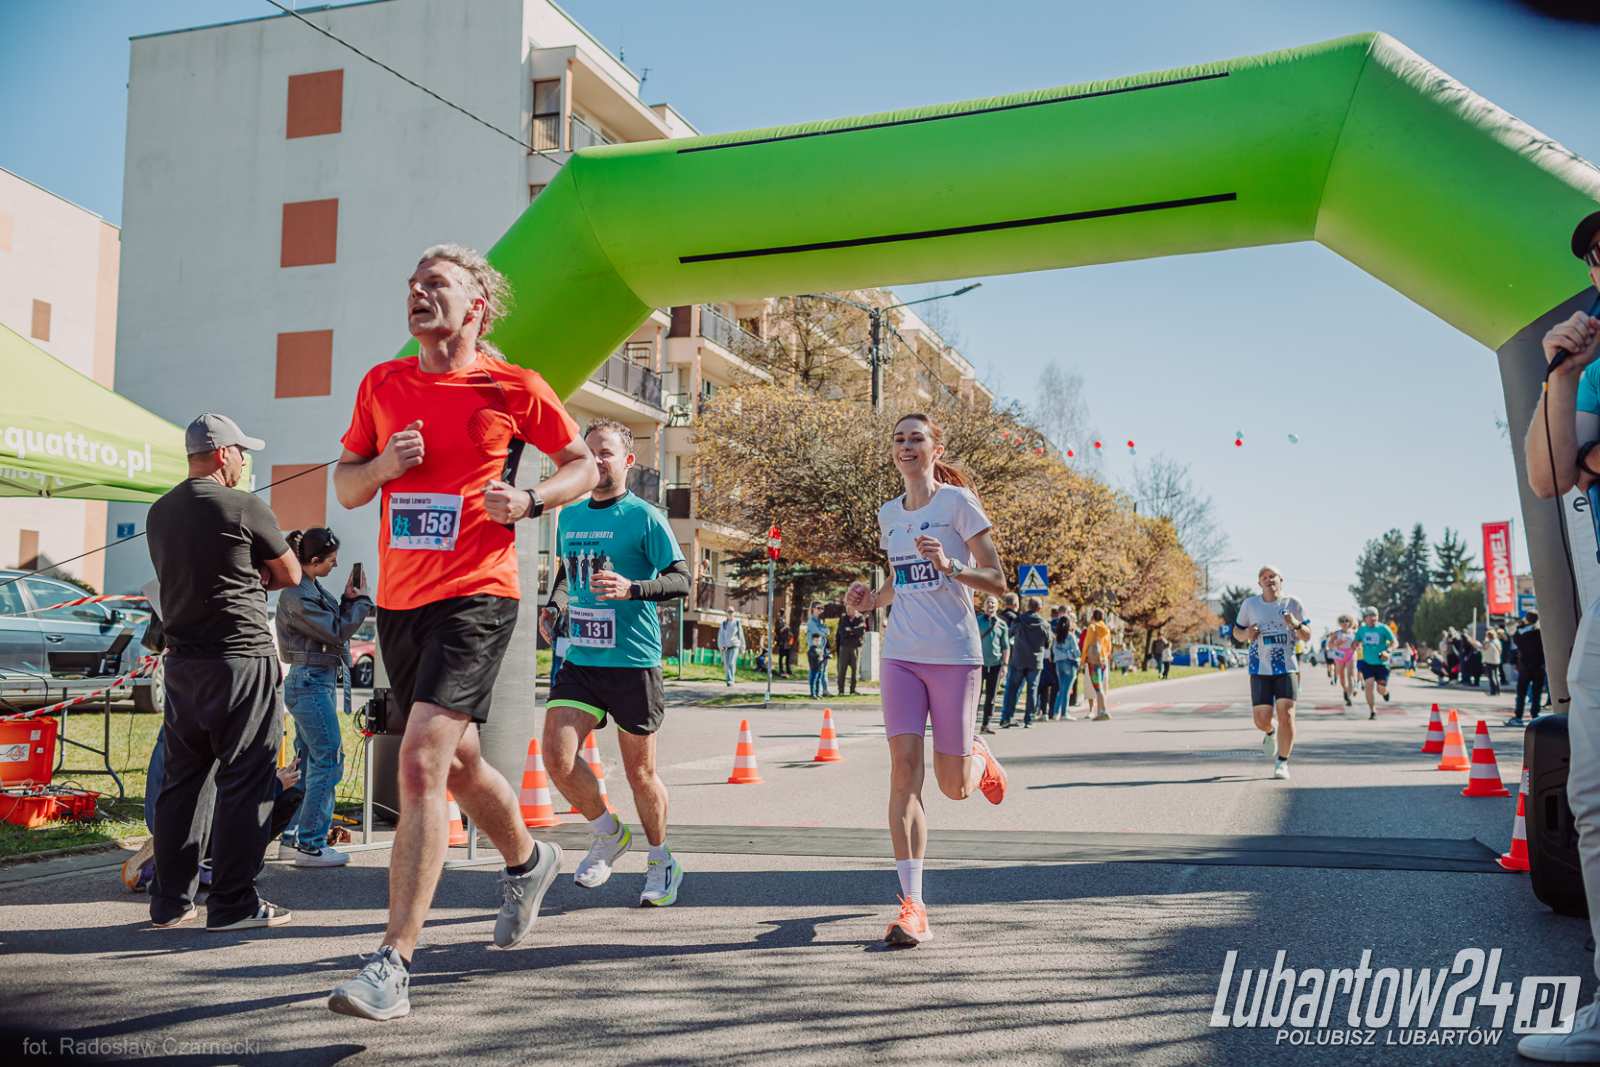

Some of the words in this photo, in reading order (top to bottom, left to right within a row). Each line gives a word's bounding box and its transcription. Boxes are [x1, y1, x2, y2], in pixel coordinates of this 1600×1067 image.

[0, 426, 152, 480] quattro.pl
[417, 512, 453, 535] 158
[911, 562, 935, 581] 021
[1489, 529, 1512, 604] NEONET
[586, 621, 608, 638] 131
